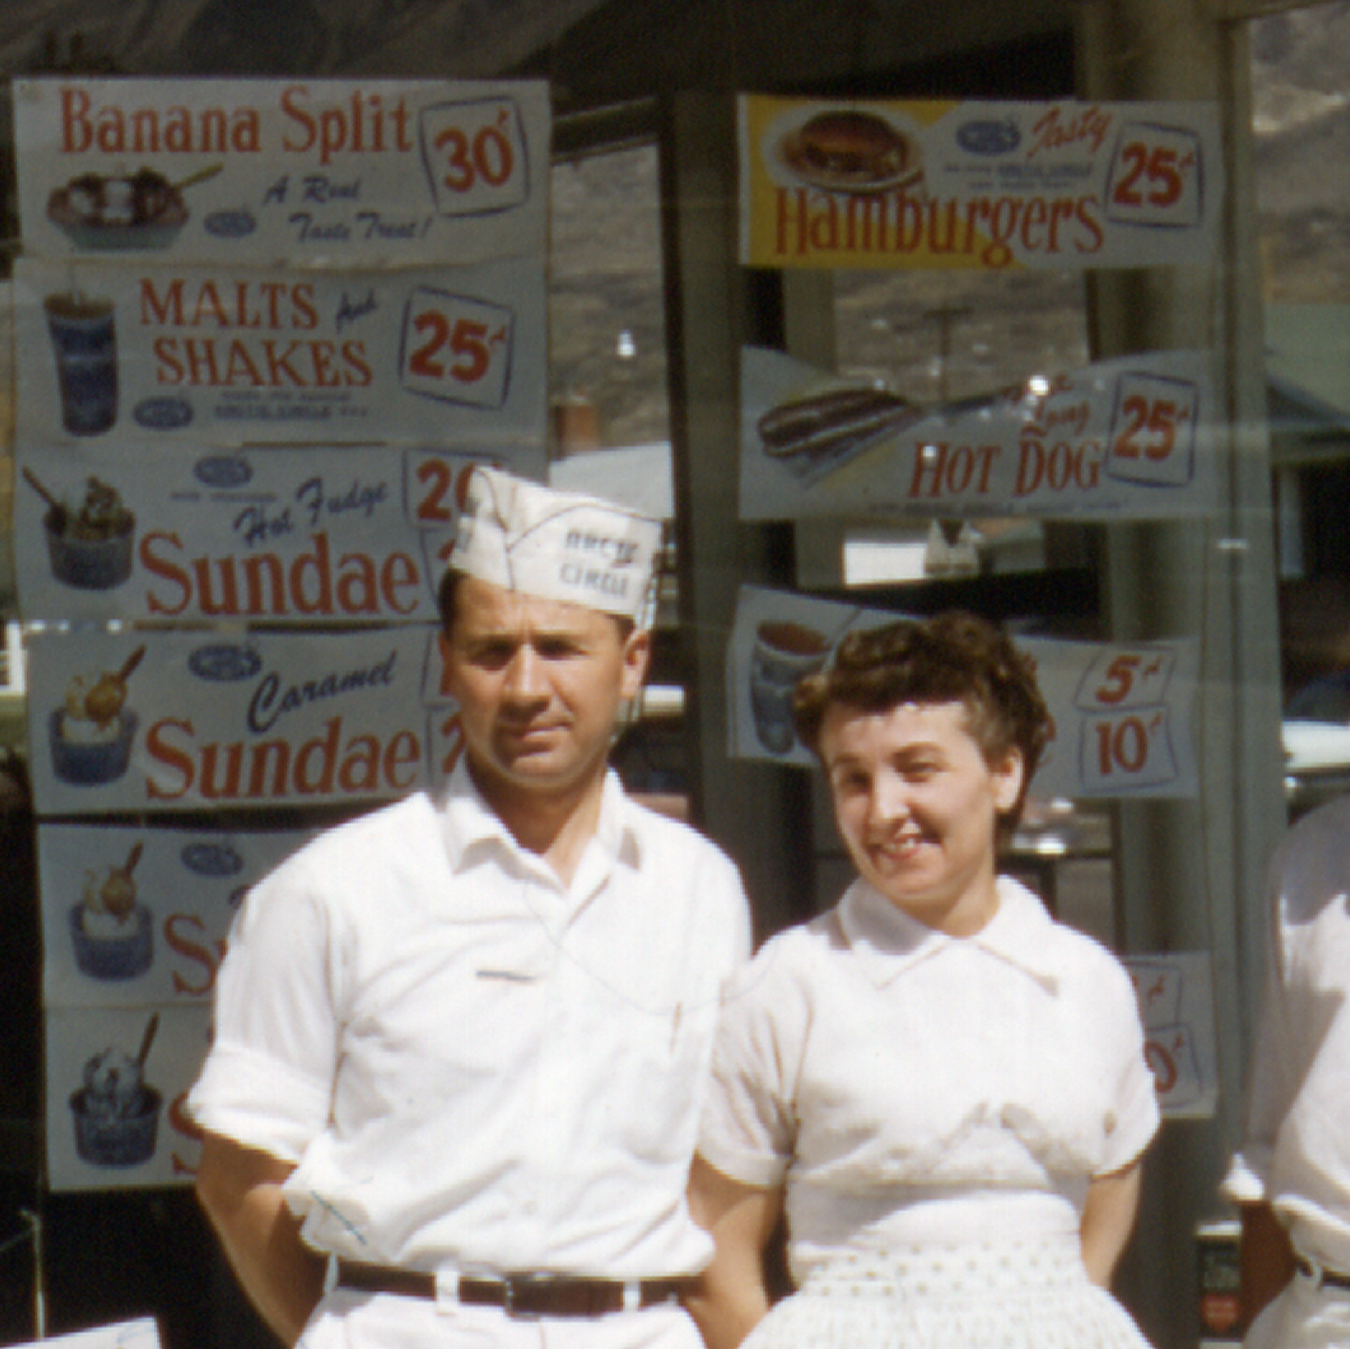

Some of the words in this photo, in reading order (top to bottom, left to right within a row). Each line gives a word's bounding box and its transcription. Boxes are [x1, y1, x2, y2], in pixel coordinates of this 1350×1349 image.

[58, 85, 262, 154] Banana
[279, 83, 415, 166] Split
[1026, 104, 1113, 158] Tasty
[261, 173, 290, 207] A
[775, 186, 1104, 268] Hamburgers
[139, 276, 320, 330] MALTS
[152, 337, 374, 389] SHAKES
[908, 440, 1001, 498] HOT
[1012, 438, 1102, 498] DOG
[233, 504, 295, 549] Hot
[295, 475, 389, 529] Fudge
[138, 530, 420, 617] Sundae
[246, 648, 398, 736] Caramel
[147, 714, 422, 802] Sundae
